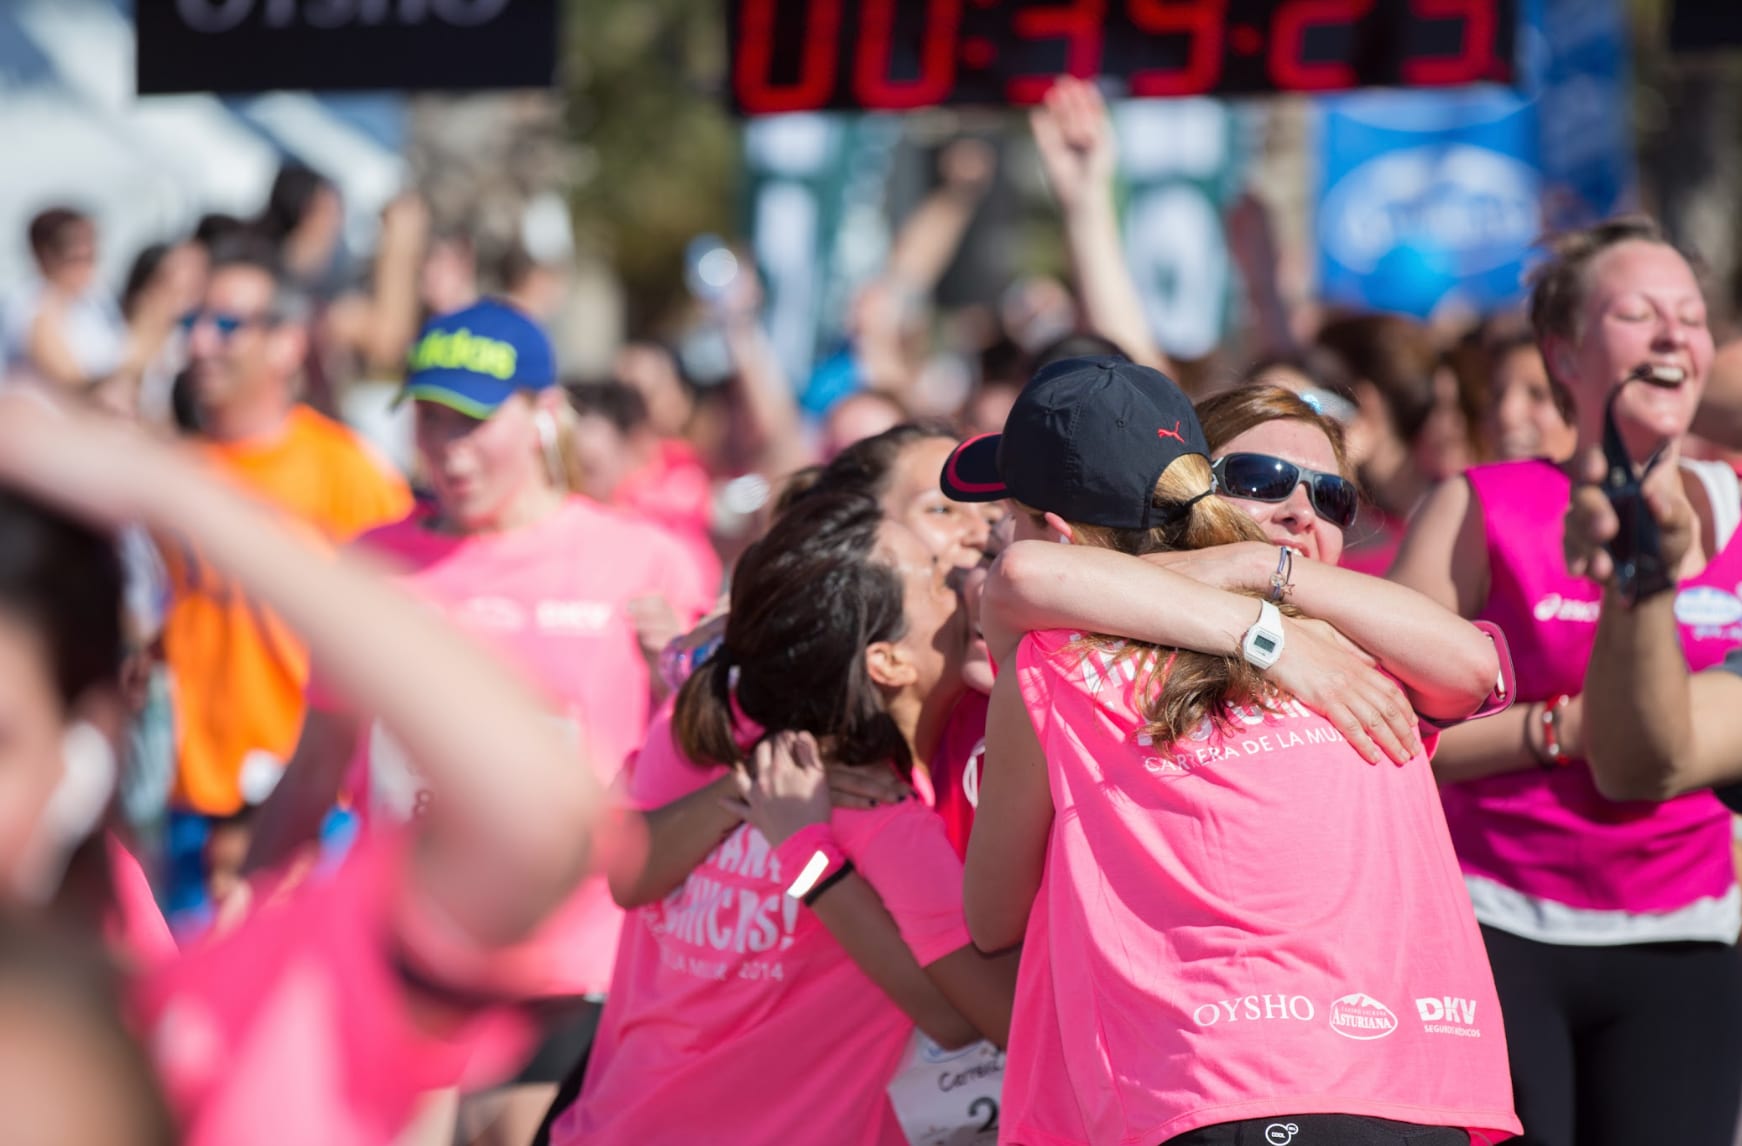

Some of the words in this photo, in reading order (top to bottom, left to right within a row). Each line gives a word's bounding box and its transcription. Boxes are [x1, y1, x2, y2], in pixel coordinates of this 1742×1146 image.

[1242, 736, 1274, 755] DE
[1276, 731, 1305, 748] LA
[1193, 994, 1316, 1027] OYSHO
[1332, 1005, 1393, 1029] ASTURIANA
[1415, 996, 1477, 1025] DKV
